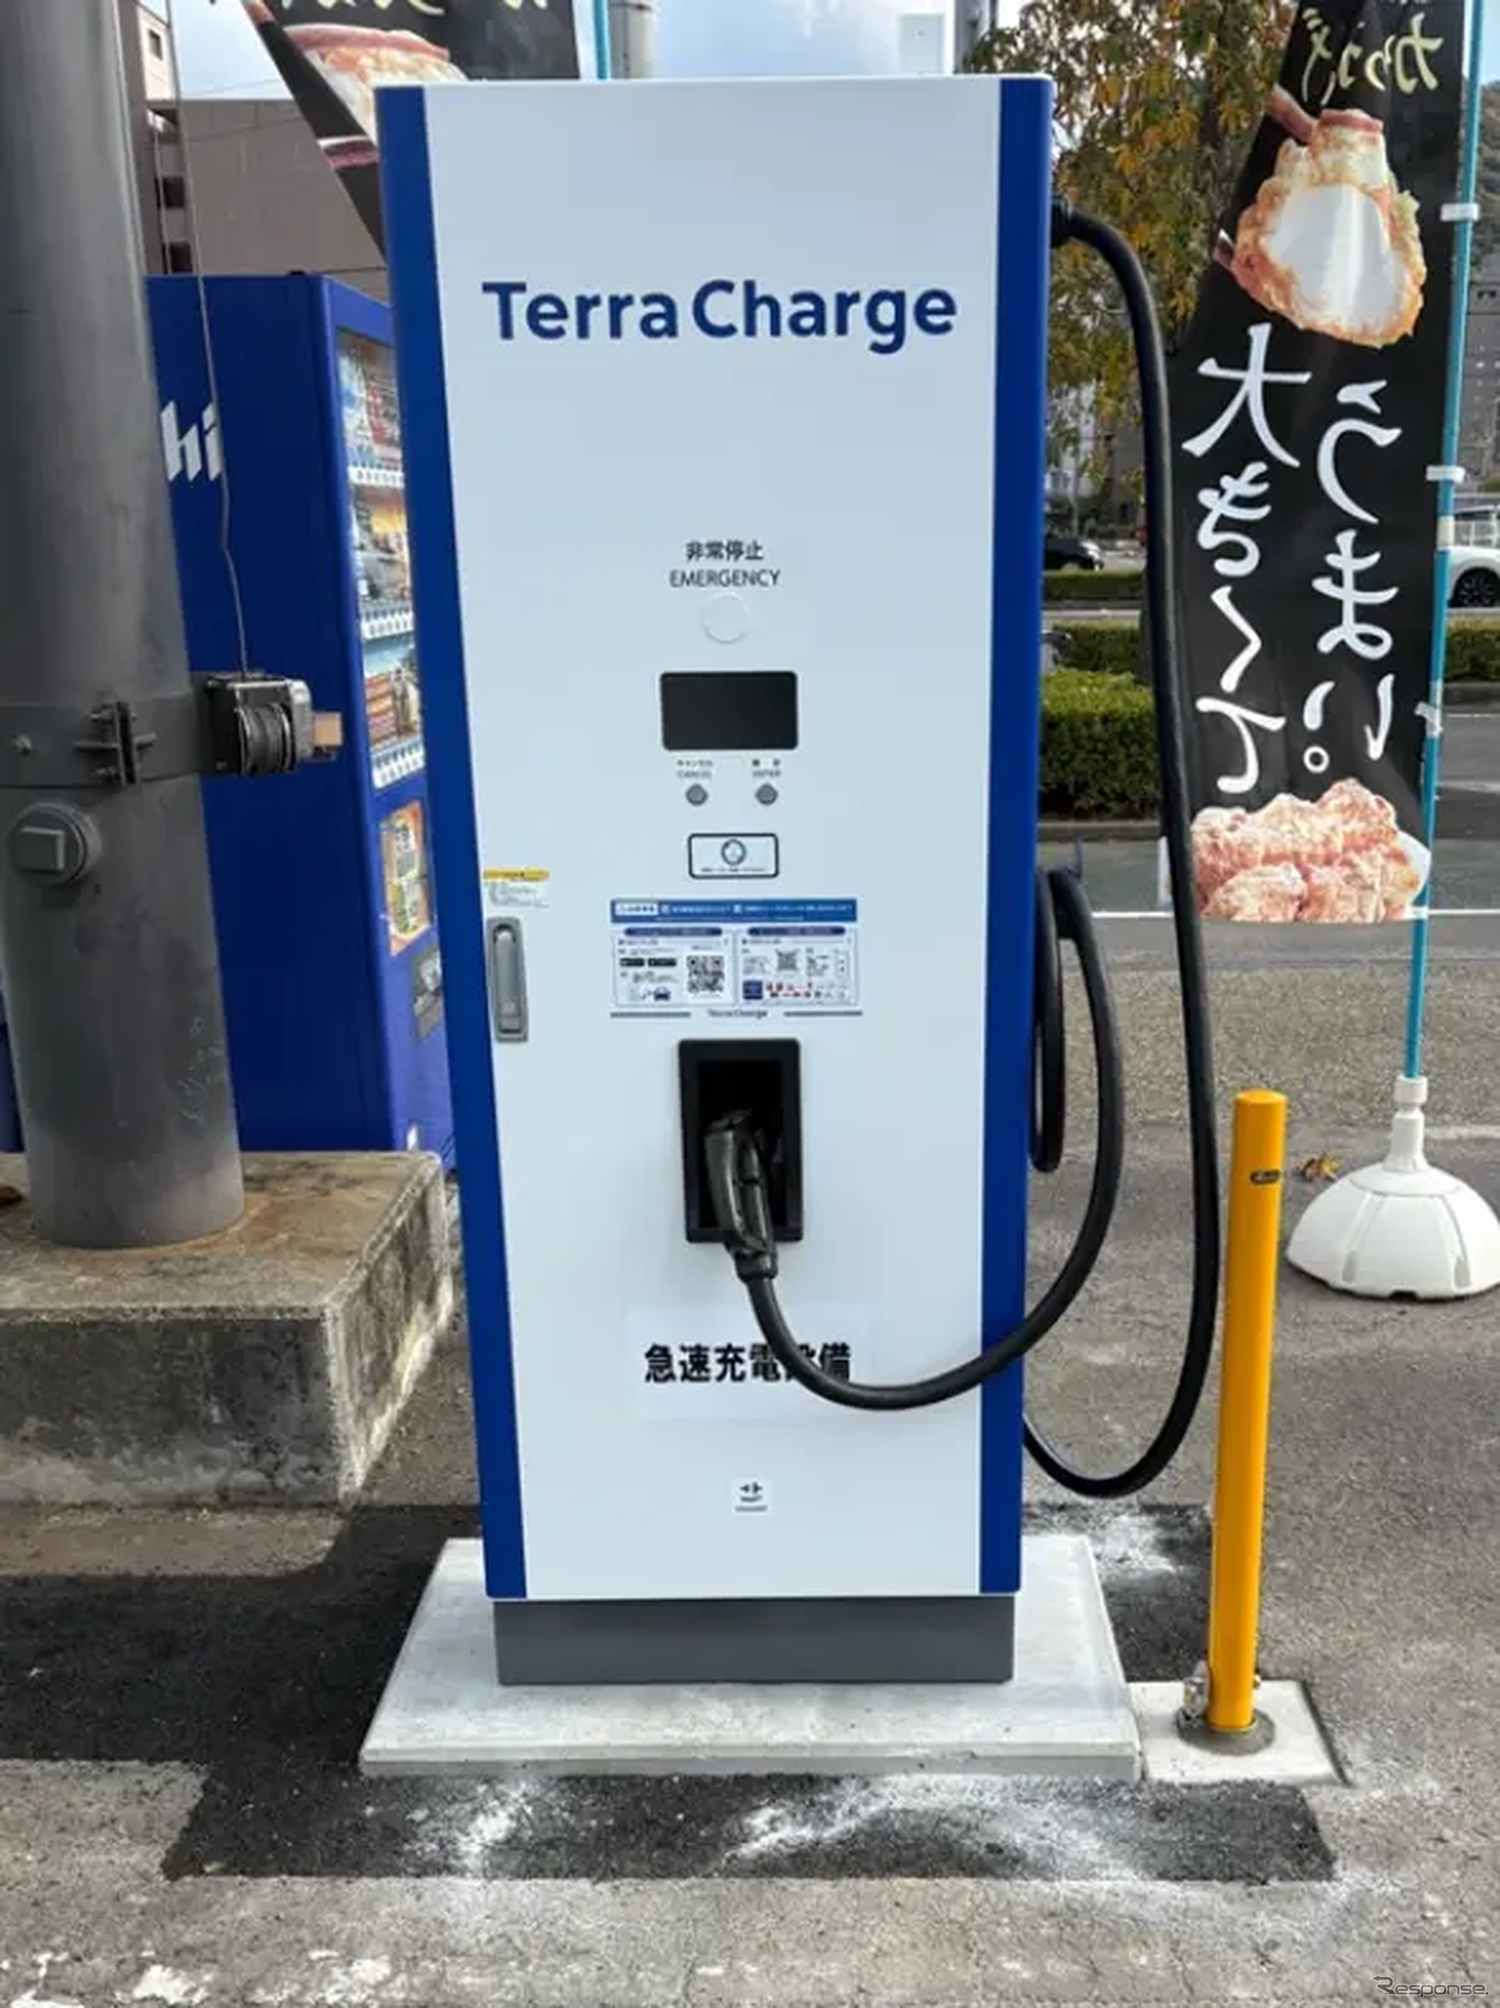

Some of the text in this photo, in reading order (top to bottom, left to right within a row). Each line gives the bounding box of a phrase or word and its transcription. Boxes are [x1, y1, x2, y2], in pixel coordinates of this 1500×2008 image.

[481, 279, 957, 355] Terra Charge
[686, 540, 764, 562] 非常停止
[669, 569, 781, 588] EMERGENCY
